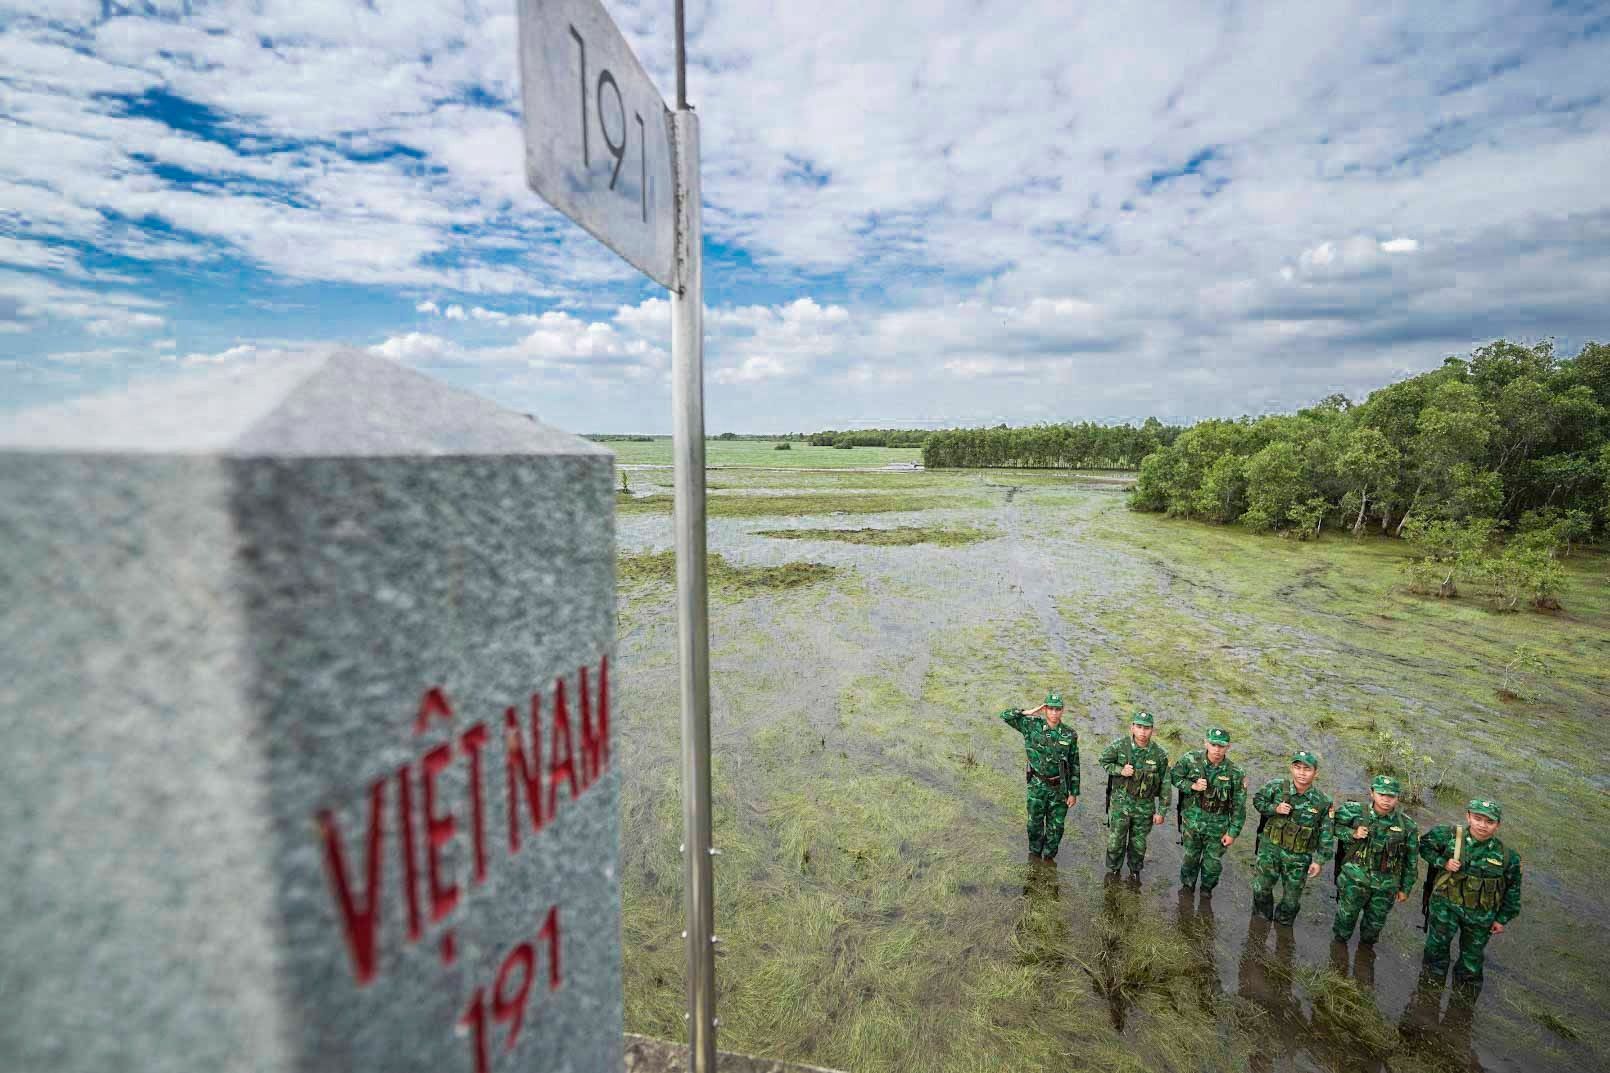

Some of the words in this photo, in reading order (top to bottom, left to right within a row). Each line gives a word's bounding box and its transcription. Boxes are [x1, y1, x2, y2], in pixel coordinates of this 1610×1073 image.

[569, 23, 647, 223] 191
[315, 685, 491, 987] VIỆT
[505, 654, 611, 854] NAM
[460, 906, 563, 1073] 191
